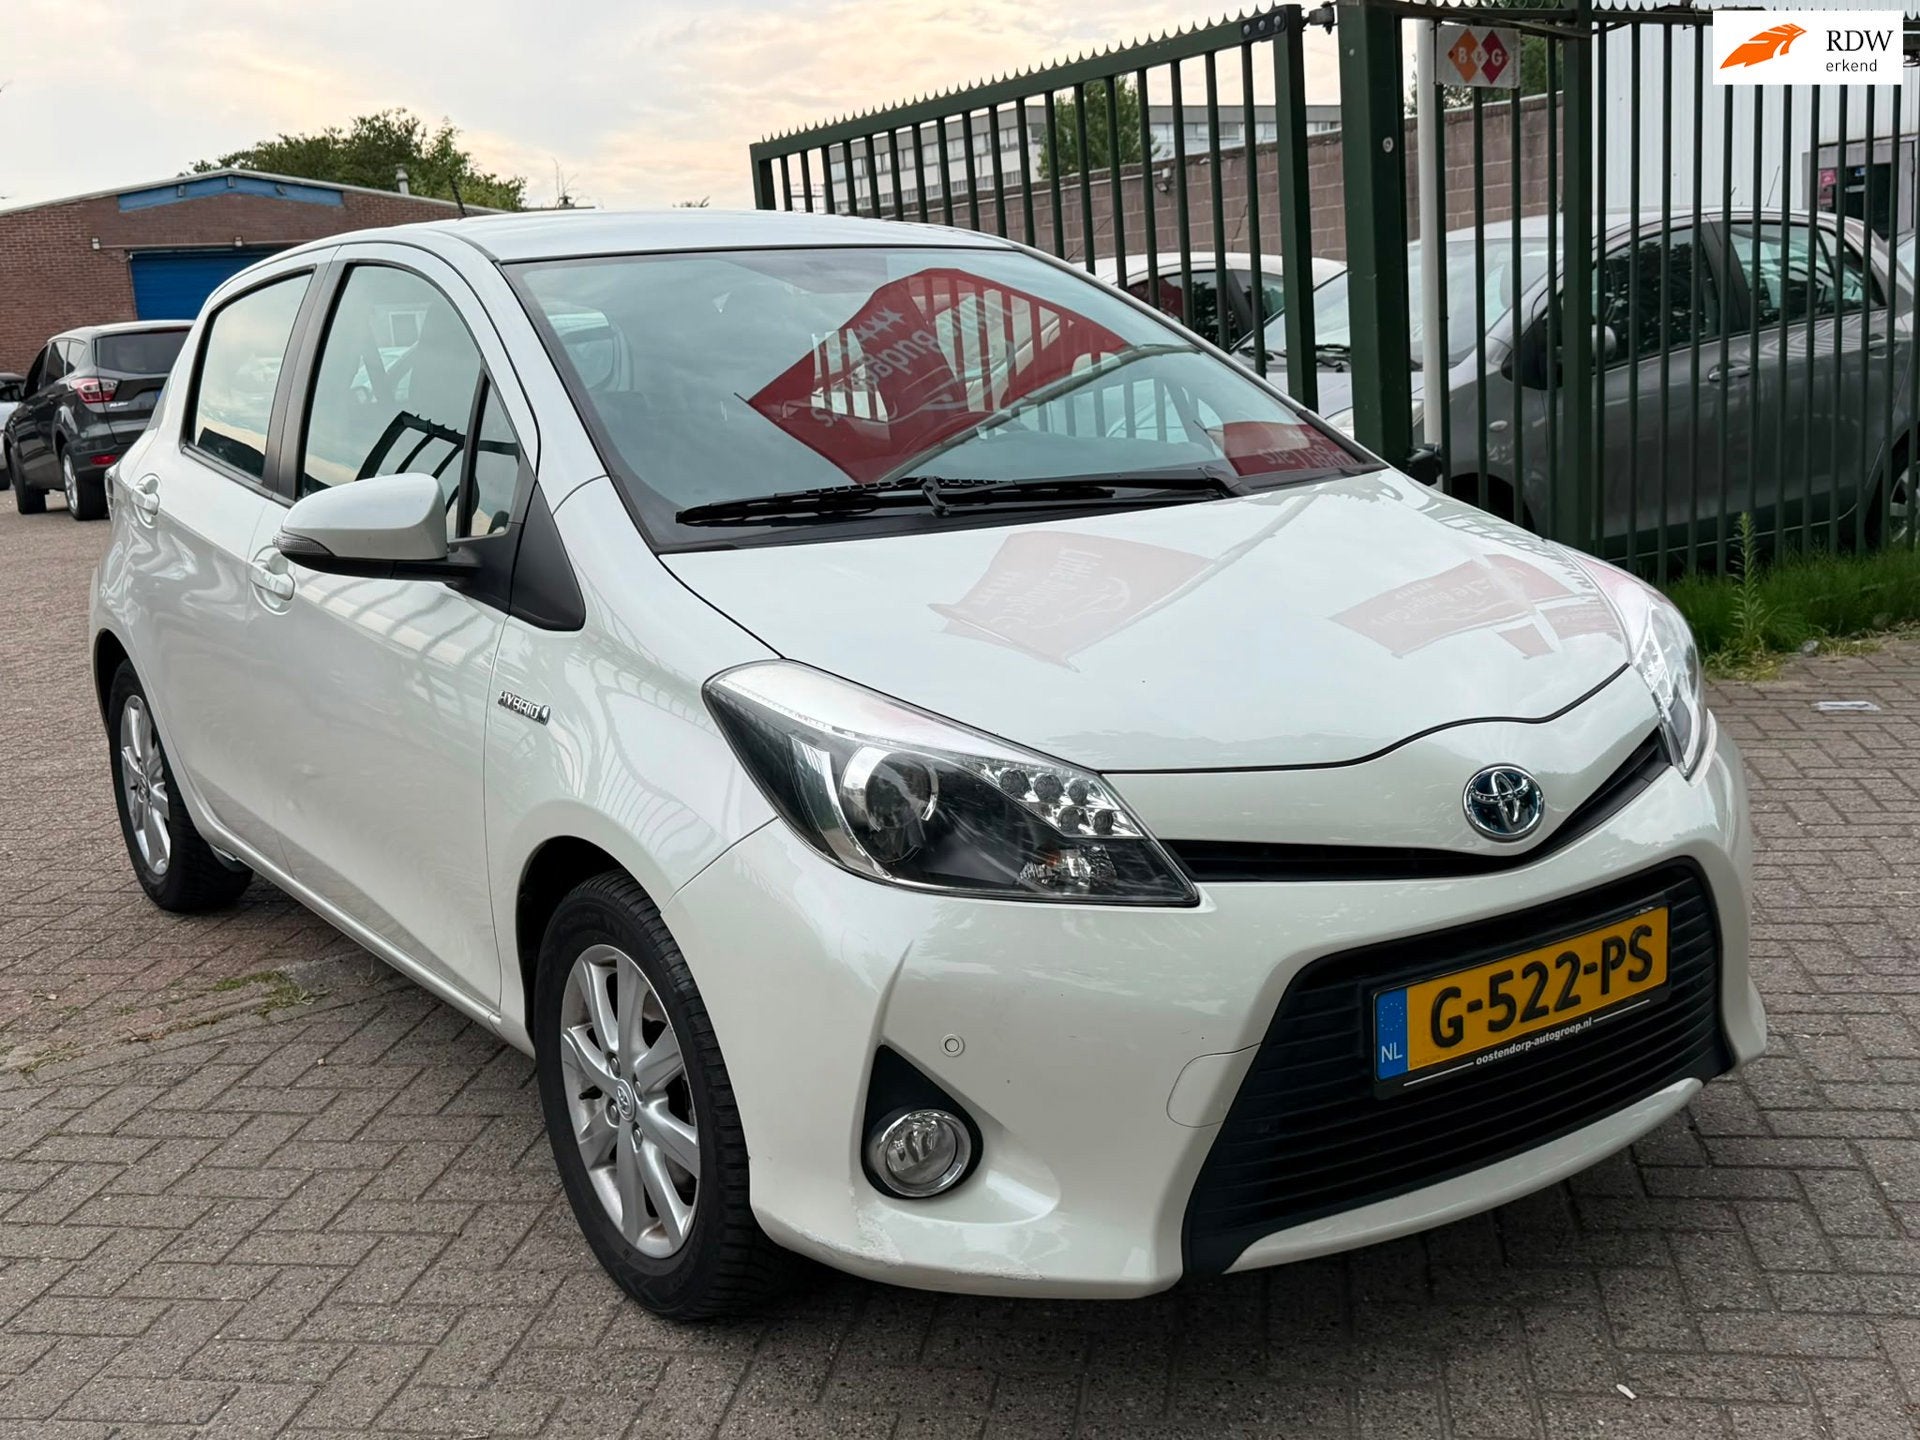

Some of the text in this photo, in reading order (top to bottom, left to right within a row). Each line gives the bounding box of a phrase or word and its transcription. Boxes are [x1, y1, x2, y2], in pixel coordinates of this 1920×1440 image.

[498, 690, 541, 719] HYBRID
[1430, 924, 1653, 1048] G-522-PS
[1380, 1042, 1403, 1063] NL
[1475, 1016, 1592, 1065] oostendorp-autogroep.nl
